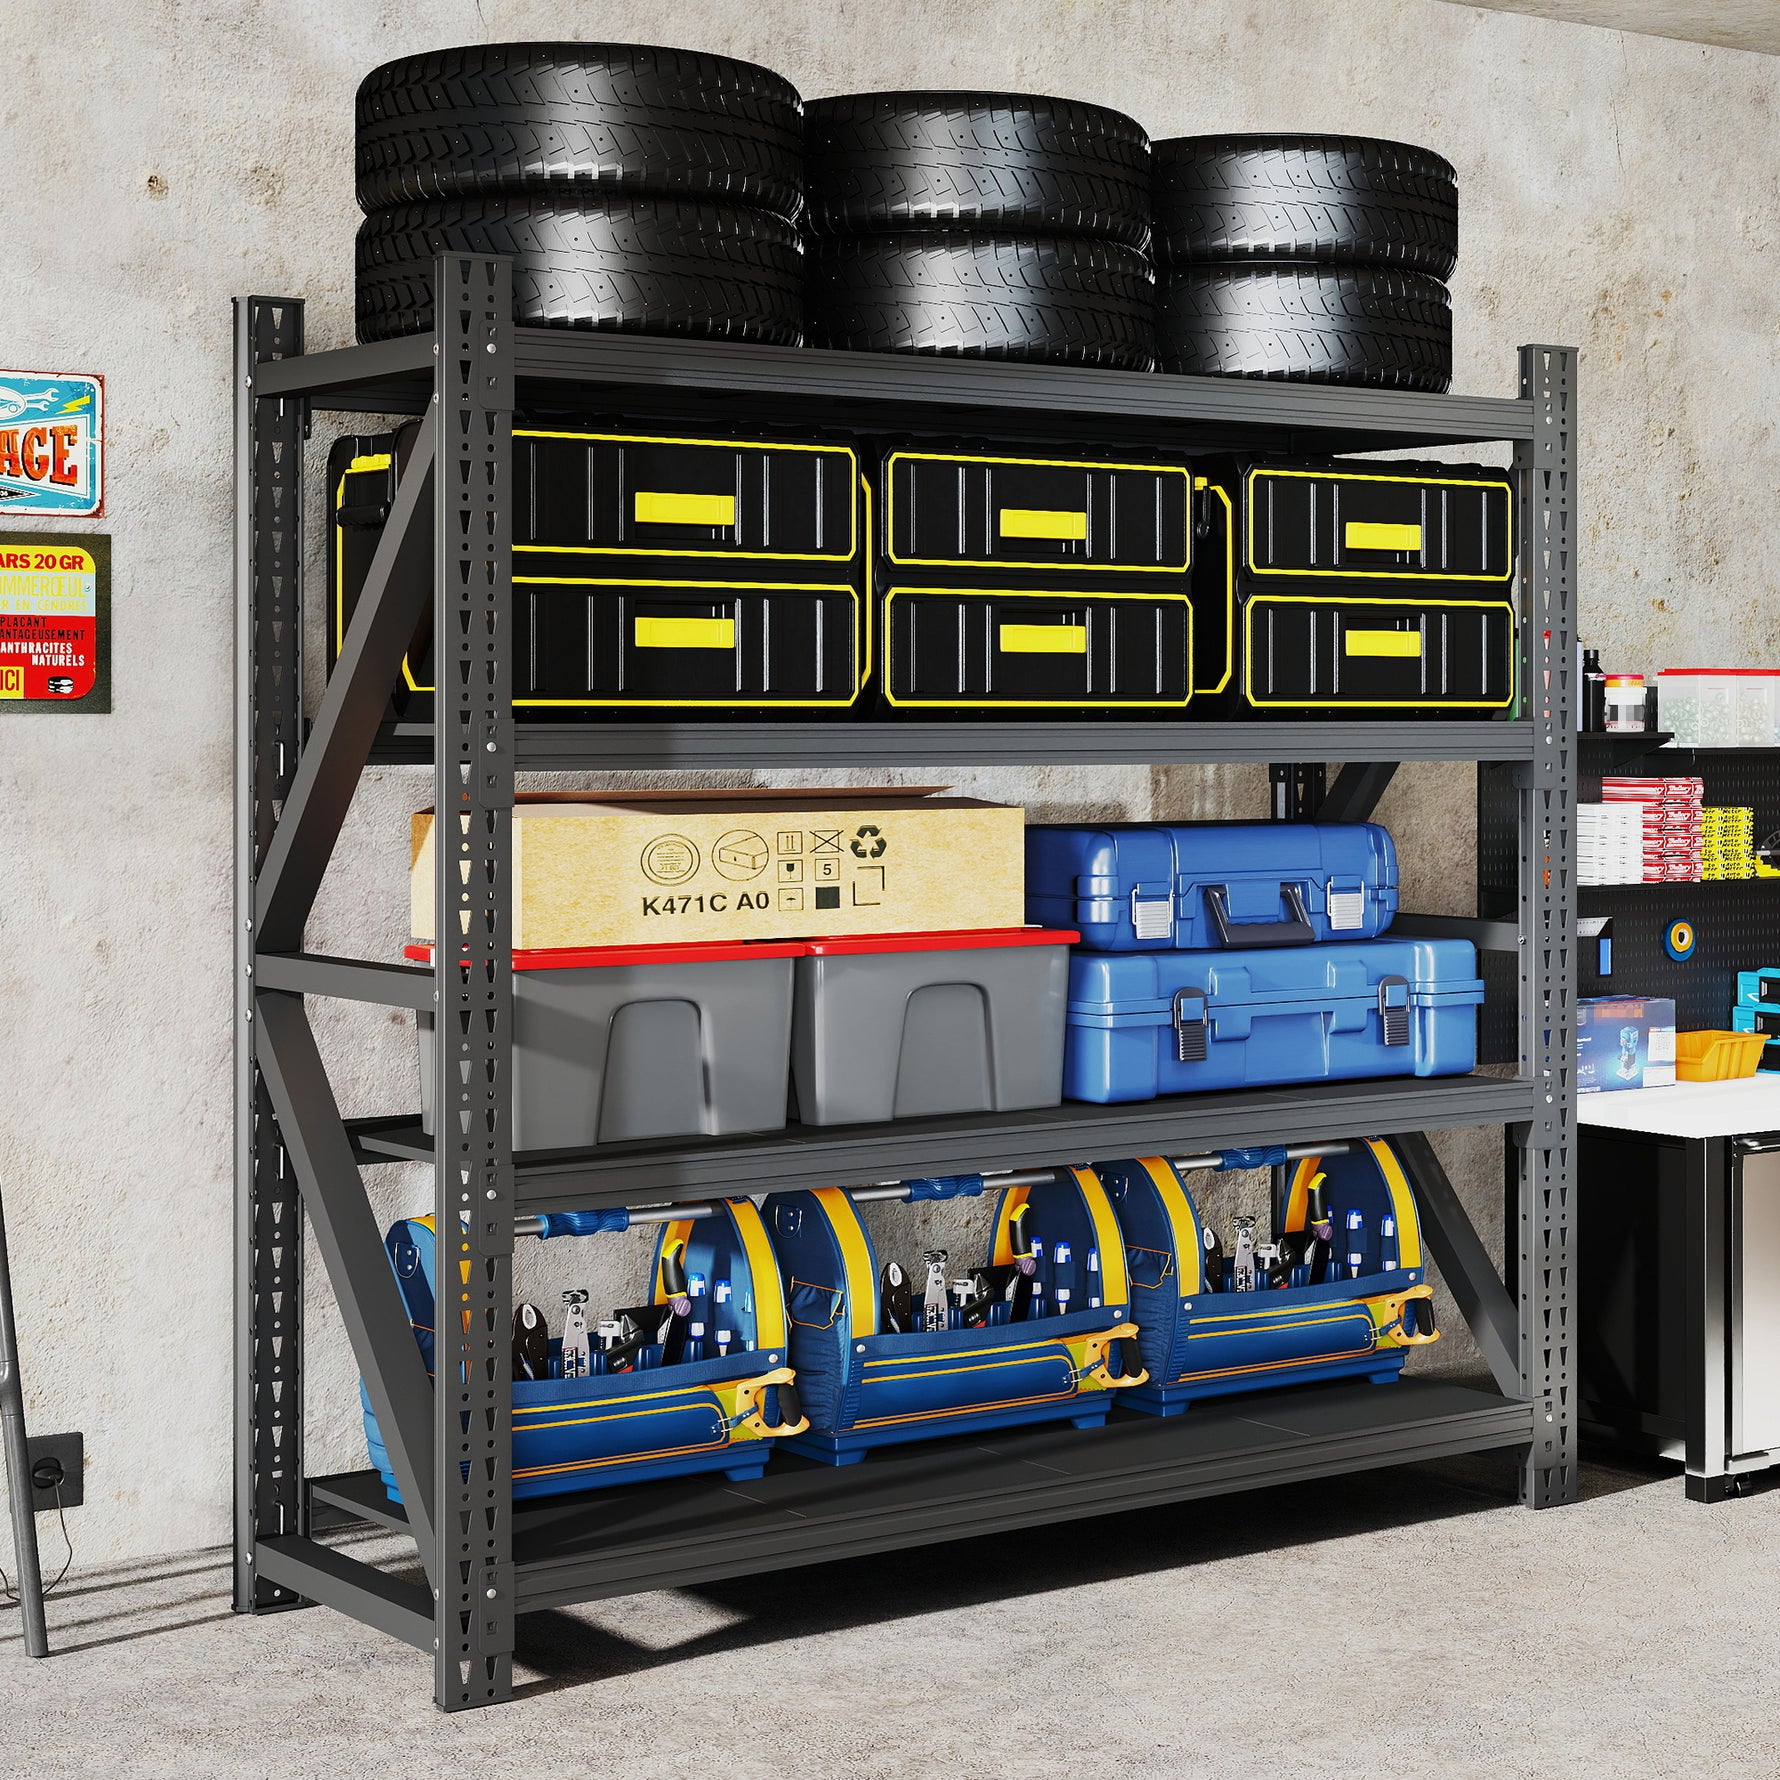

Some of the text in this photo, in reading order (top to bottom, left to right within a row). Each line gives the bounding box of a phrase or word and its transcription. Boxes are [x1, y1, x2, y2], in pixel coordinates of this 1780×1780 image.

[34, 553, 57, 570] 20
[59, 554, 84, 571] GR
[0, 575, 87, 599] MMERŒUL
[16, 599, 31, 611] EN
[37, 599, 89, 613] CENDRES
[0, 641, 73, 654] ANTHRACITES
[31, 654, 85, 667] NATURELS
[822, 864, 832, 876] 5
[642, 891, 728, 916] K471C
